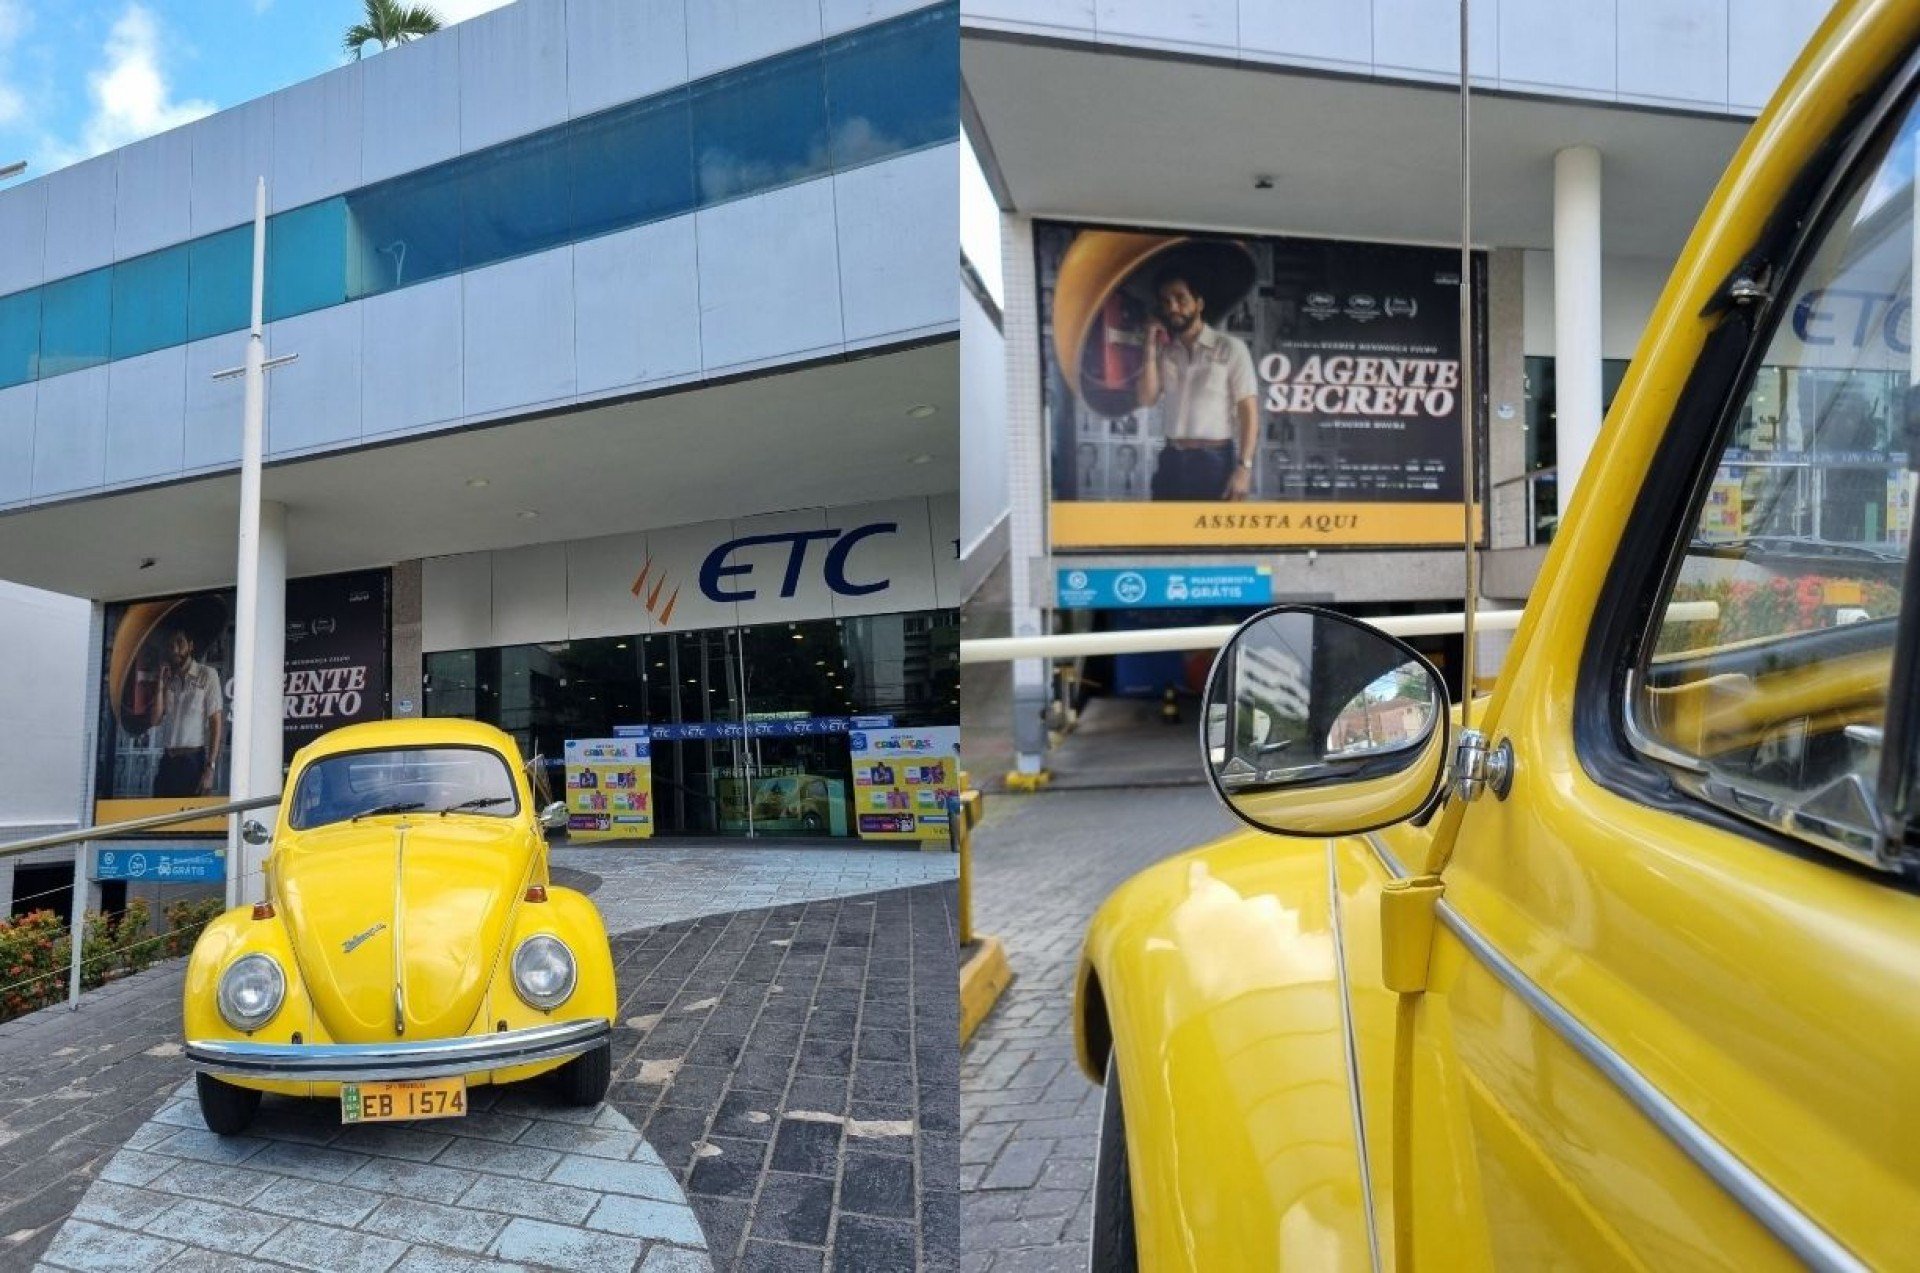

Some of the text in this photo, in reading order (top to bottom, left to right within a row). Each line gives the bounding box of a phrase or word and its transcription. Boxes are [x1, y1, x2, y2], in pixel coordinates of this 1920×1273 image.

[1258, 353, 1459, 389] O AGENTE
[1265, 383, 1454, 417] SECRETO
[1193, 514, 1359, 533] ASSISTA AQUI
[698, 522, 898, 603] ETC
[363, 1093, 393, 1118] EB
[409, 1090, 463, 1115] 1574
